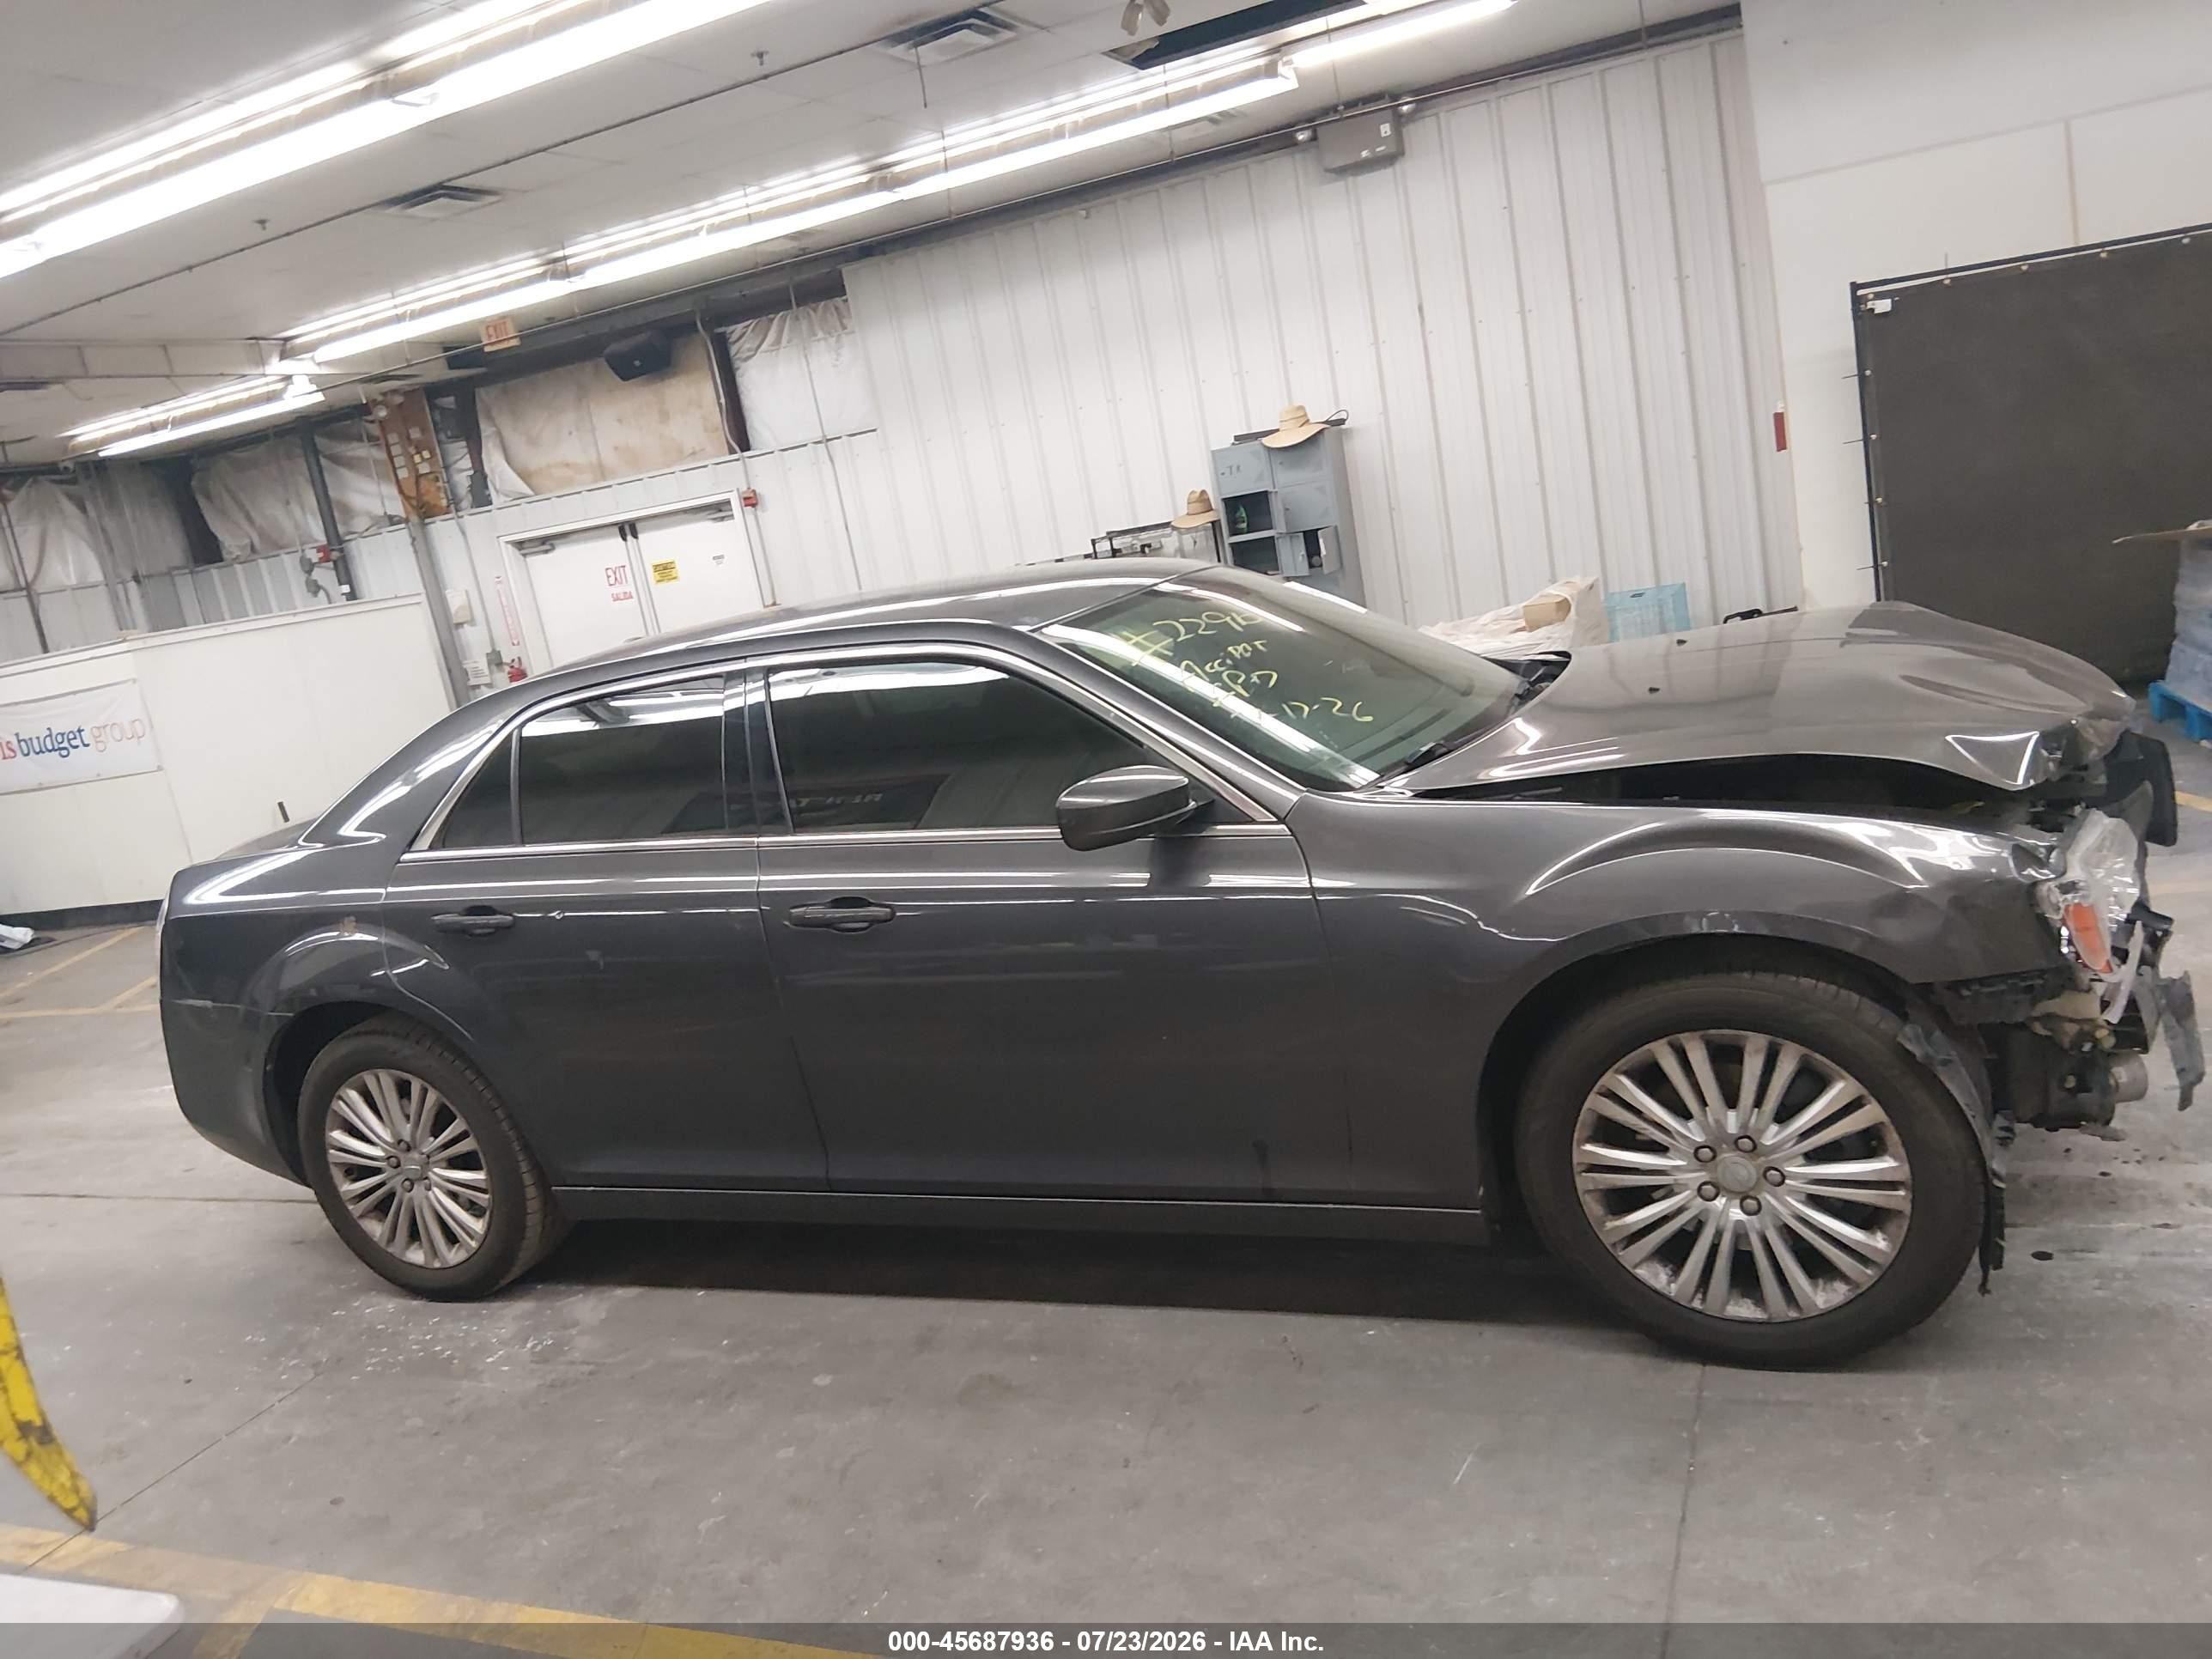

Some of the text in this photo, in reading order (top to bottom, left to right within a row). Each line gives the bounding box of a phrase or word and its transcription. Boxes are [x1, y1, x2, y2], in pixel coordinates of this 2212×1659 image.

[605, 565, 628, 586] EXIT
[14, 726, 90, 758] budget
[90, 719, 145, 752] group
